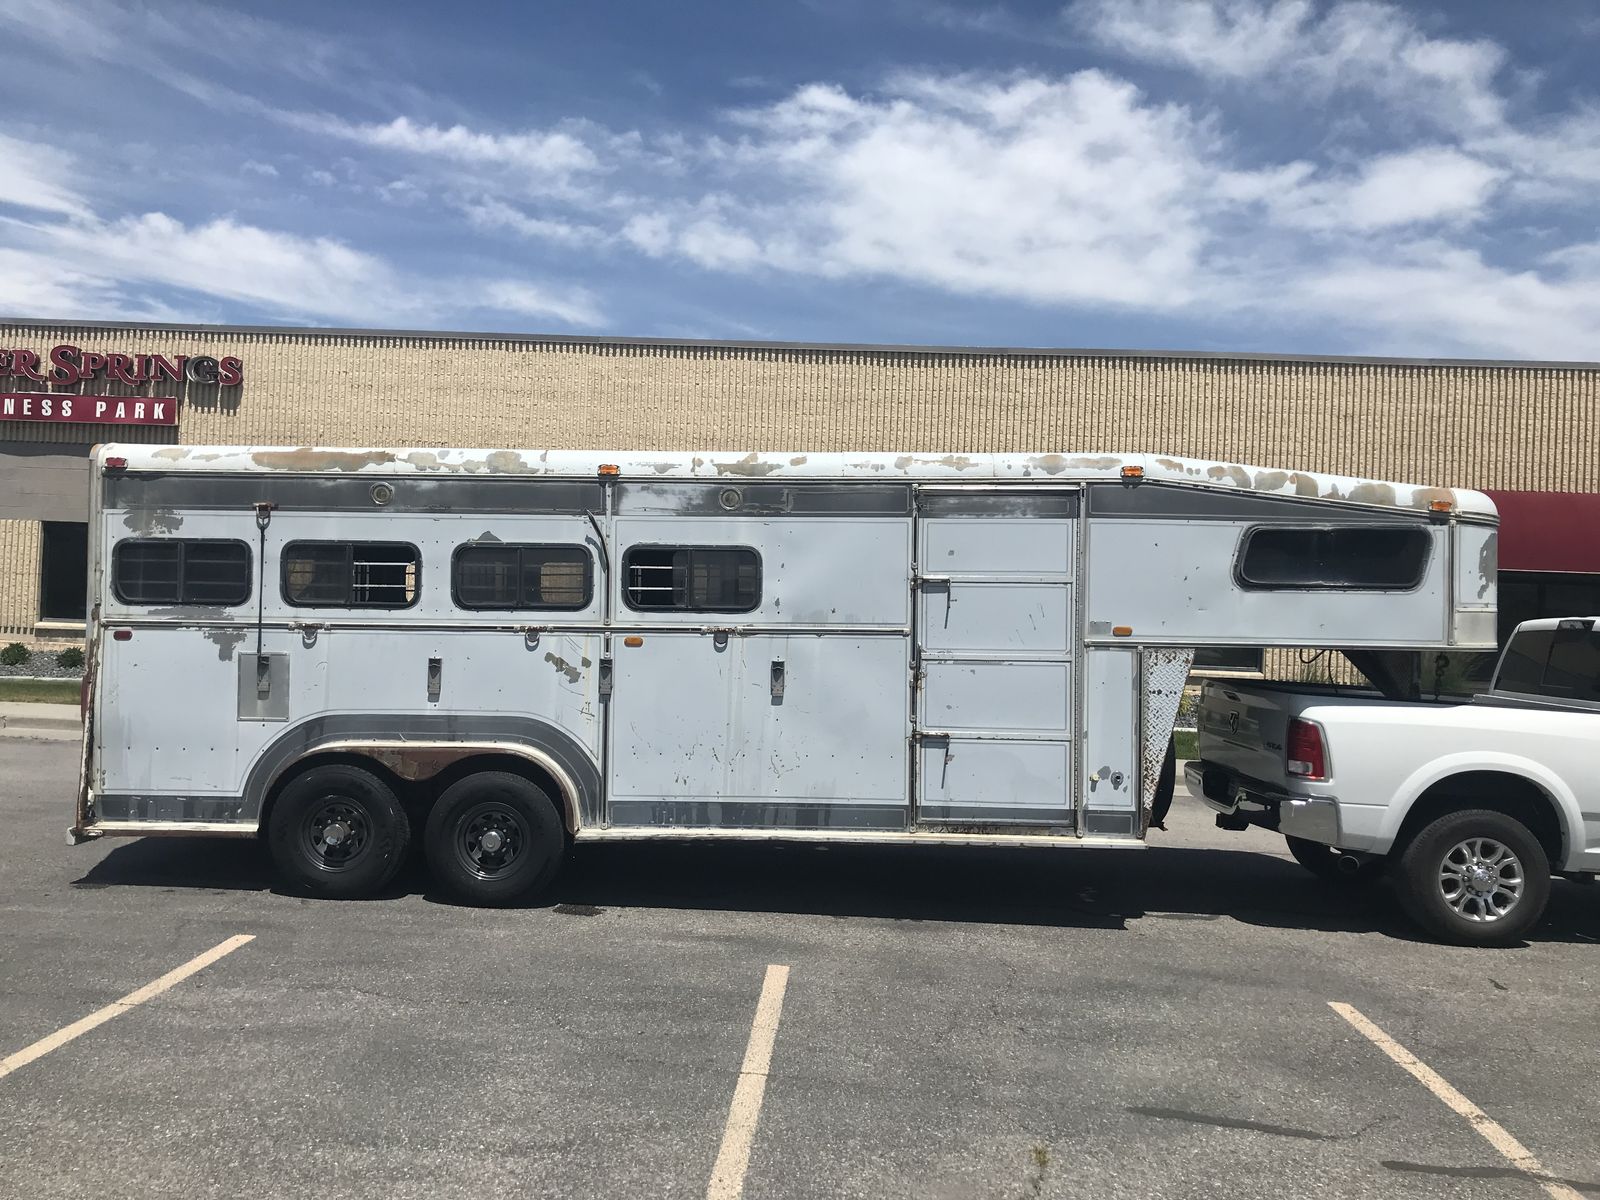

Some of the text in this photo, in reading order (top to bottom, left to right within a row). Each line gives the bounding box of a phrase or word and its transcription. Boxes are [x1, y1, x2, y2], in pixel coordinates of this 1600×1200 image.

[48, 344, 244, 386] SPRINGS
[3, 398, 165, 420] NESS PARK
